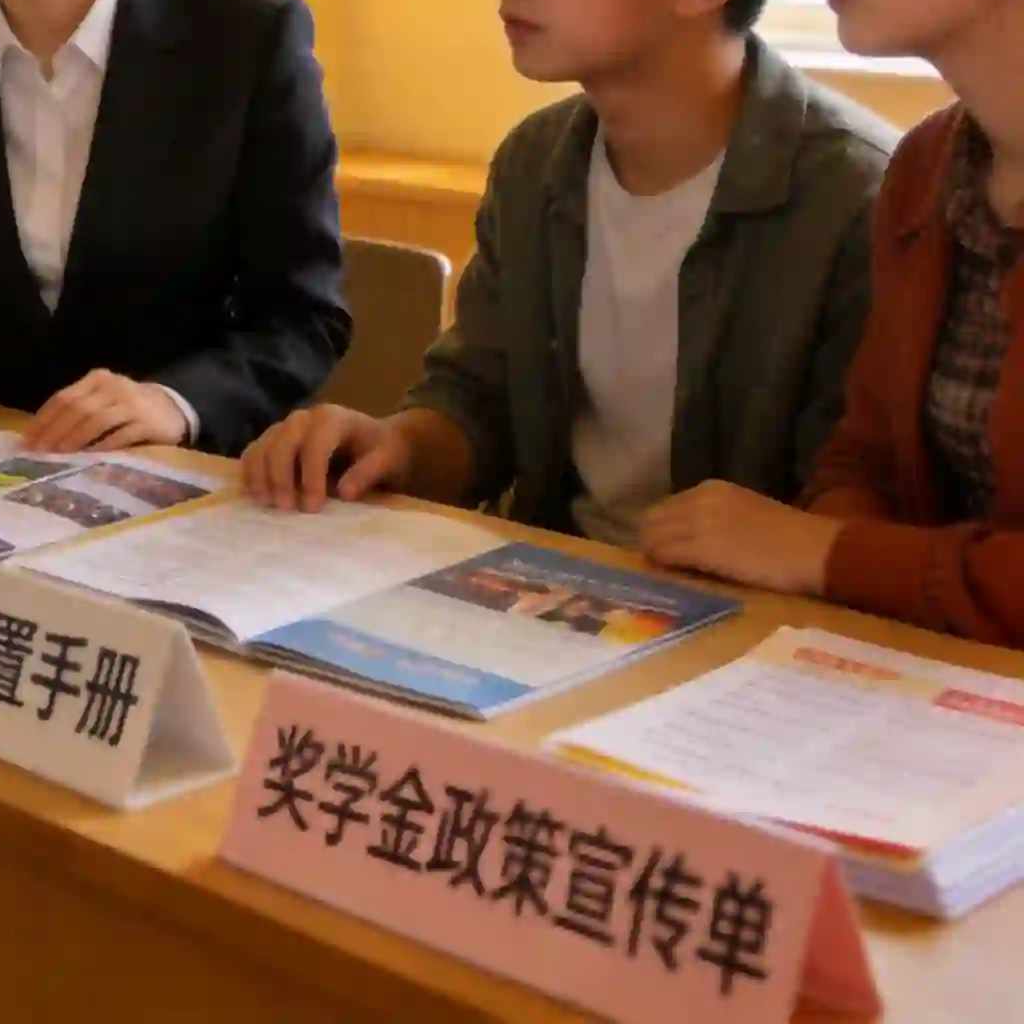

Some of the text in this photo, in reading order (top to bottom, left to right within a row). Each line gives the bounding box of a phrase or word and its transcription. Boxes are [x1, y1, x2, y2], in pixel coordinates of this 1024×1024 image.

[257, 724, 775, 997] 奖学金政策宣传单
